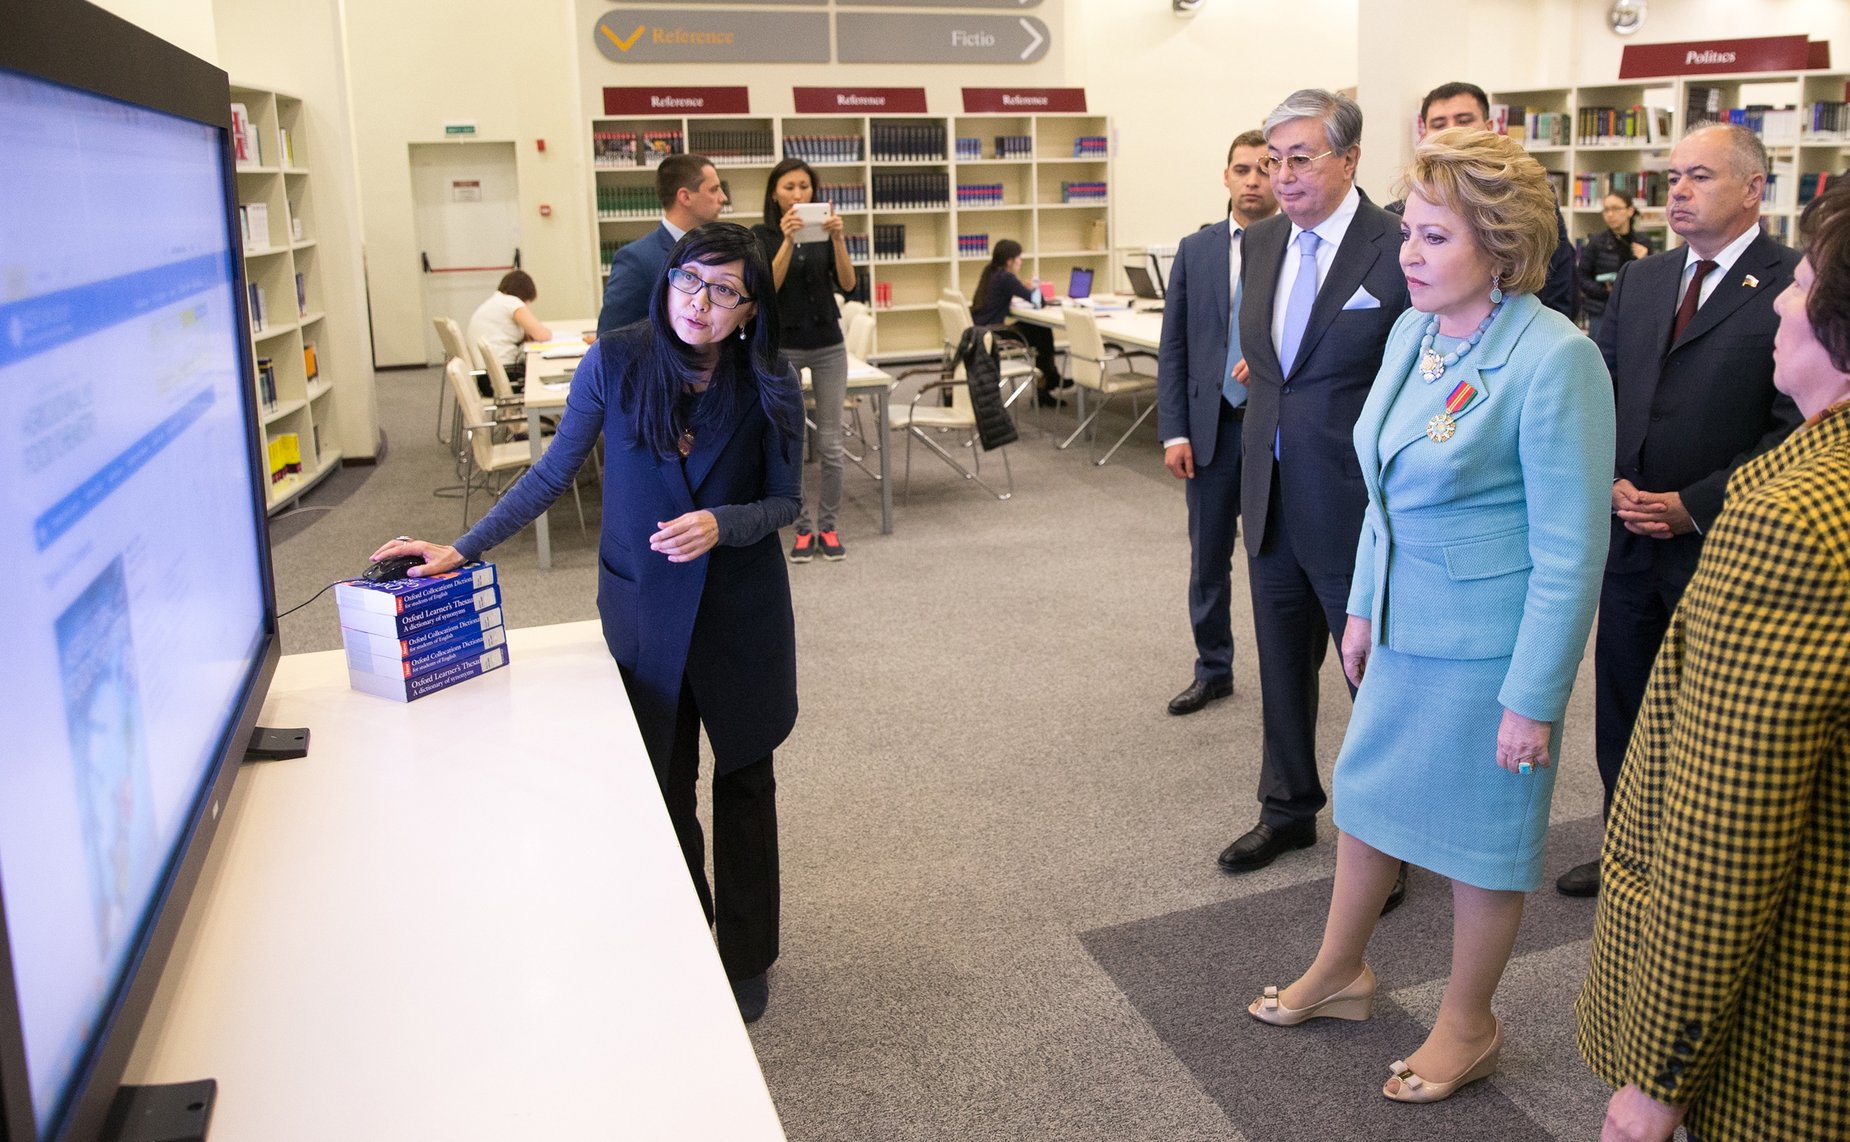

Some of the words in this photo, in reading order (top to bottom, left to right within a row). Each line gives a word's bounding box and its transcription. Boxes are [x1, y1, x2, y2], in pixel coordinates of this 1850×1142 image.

[652, 26, 734, 44] Reference
[951, 30, 995, 47] Fictio
[1685, 49, 1737, 65] Politics
[651, 95, 704, 108] Reference
[836, 94, 886, 106] Reference
[1002, 94, 1049, 106] Reference
[403, 591, 423, 602] Oxford
[422, 581, 454, 597] Collocations
[411, 598, 429, 607] students
[433, 590, 449, 600] English
[402, 611, 424, 625] Oxford
[425, 602, 453, 618] Learner's
[403, 625, 410, 633] A
[409, 618, 435, 631] dictionary
[441, 608, 466, 621] synonyms
[408, 634, 427, 646] Oxford
[427, 625, 459, 639] Collocations
[416, 641, 434, 650] students
[438, 633, 454, 642] English
[411, 654, 430, 667] Oxford
[430, 644, 462, 660] Collocations
[419, 661, 437, 671] students
[441, 653, 457, 663] English
[411, 675, 434, 688] Oxford
[434, 664, 462, 680] Learner's
[412, 689, 419, 697] A
[418, 682, 444, 696] dictionary
[450, 669, 475, 684] synonyms
